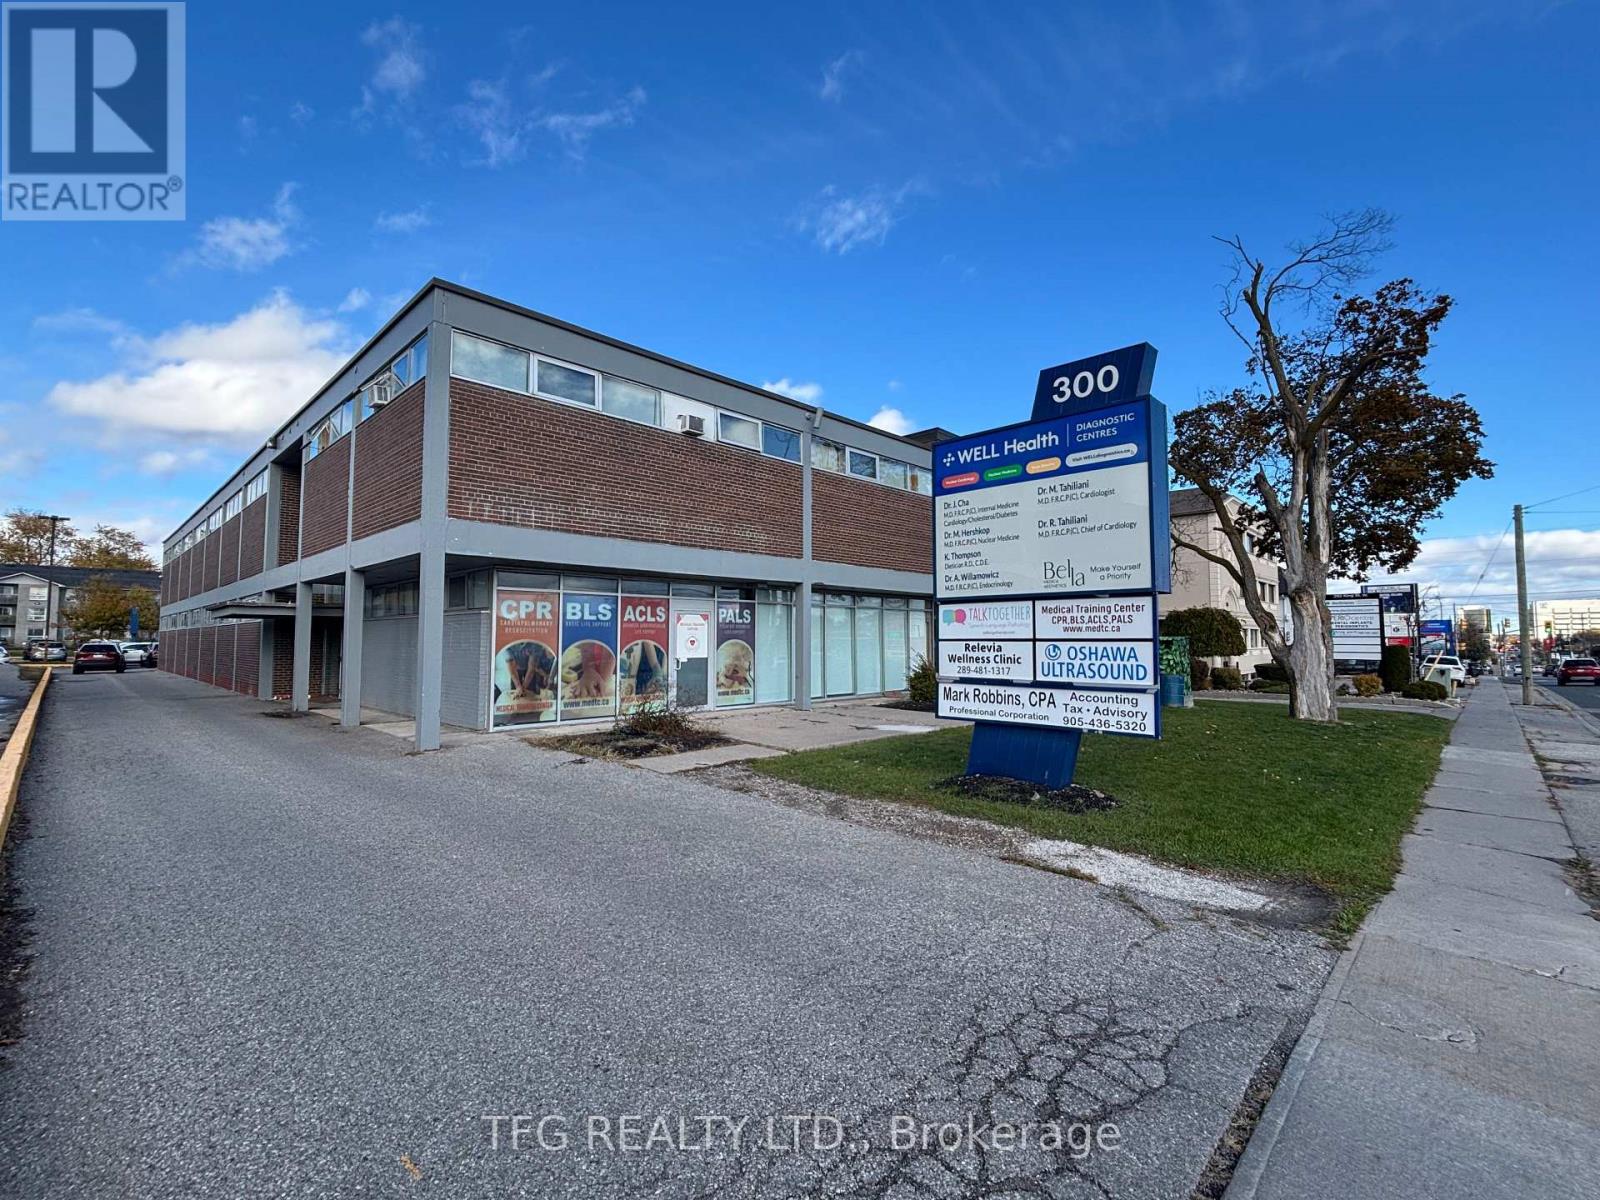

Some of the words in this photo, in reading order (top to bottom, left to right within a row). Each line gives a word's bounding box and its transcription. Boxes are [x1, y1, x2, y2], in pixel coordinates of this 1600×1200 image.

[1052, 364, 1119, 403] 300
[1076, 413, 1135, 432] DIAGNOSTIC
[1076, 428, 1118, 442] CENTRES
[958, 444, 1000, 464] WELL
[1004, 431, 1059, 456] Health
[1037, 486, 1047, 495] Dr.
[1049, 485, 1058, 493] M.
[1060, 480, 1089, 492] Tahiliani
[1080, 488, 1116, 499] Cardiologist
[1050, 519, 1057, 527] R.
[1058, 515, 1088, 525] Tahiliani
[1081, 525, 1096, 533] Chief
[1104, 521, 1137, 530] Cardiology
[962, 528, 990, 537] Hershkop
[951, 552, 981, 560] Thompson
[1044, 558, 1085, 586] Bella
[500, 600, 552, 620] CPR
[566, 602, 612, 620] BLS
[624, 605, 666, 622] ACLS
[719, 608, 751, 623] PALS
[969, 606, 1031, 621] TALKTOGETHER
[1042, 604, 1074, 614] Medical
[1076, 604, 1111, 614] Training
[1114, 603, 1145, 612] Center
[1052, 614, 1133, 625] CPR,BLS,ACLS,PALS
[964, 642, 1002, 652] Relevia
[1067, 646, 1138, 662] OSHAWA
[948, 654, 990, 664] Wellness
[993, 654, 1022, 664] Clinic
[957, 666, 1011, 675] 289-481-1317
[1041, 662, 1147, 681] ULTRASOUND
[563, 699, 610, 708] www.medtc.ca
[944, 686, 970, 702] Mark
[974, 688, 1025, 708] Robbins,
[1029, 691, 1057, 708] CPA
[1070, 692, 1139, 707] Accounting
[949, 706, 996, 717] Professional
[999, 709, 1050, 720] Corporation
[1063, 704, 1083, 714] Tax
[1093, 705, 1148, 720] Advisory
[1063, 716, 1146, 732] 905-436-5320
